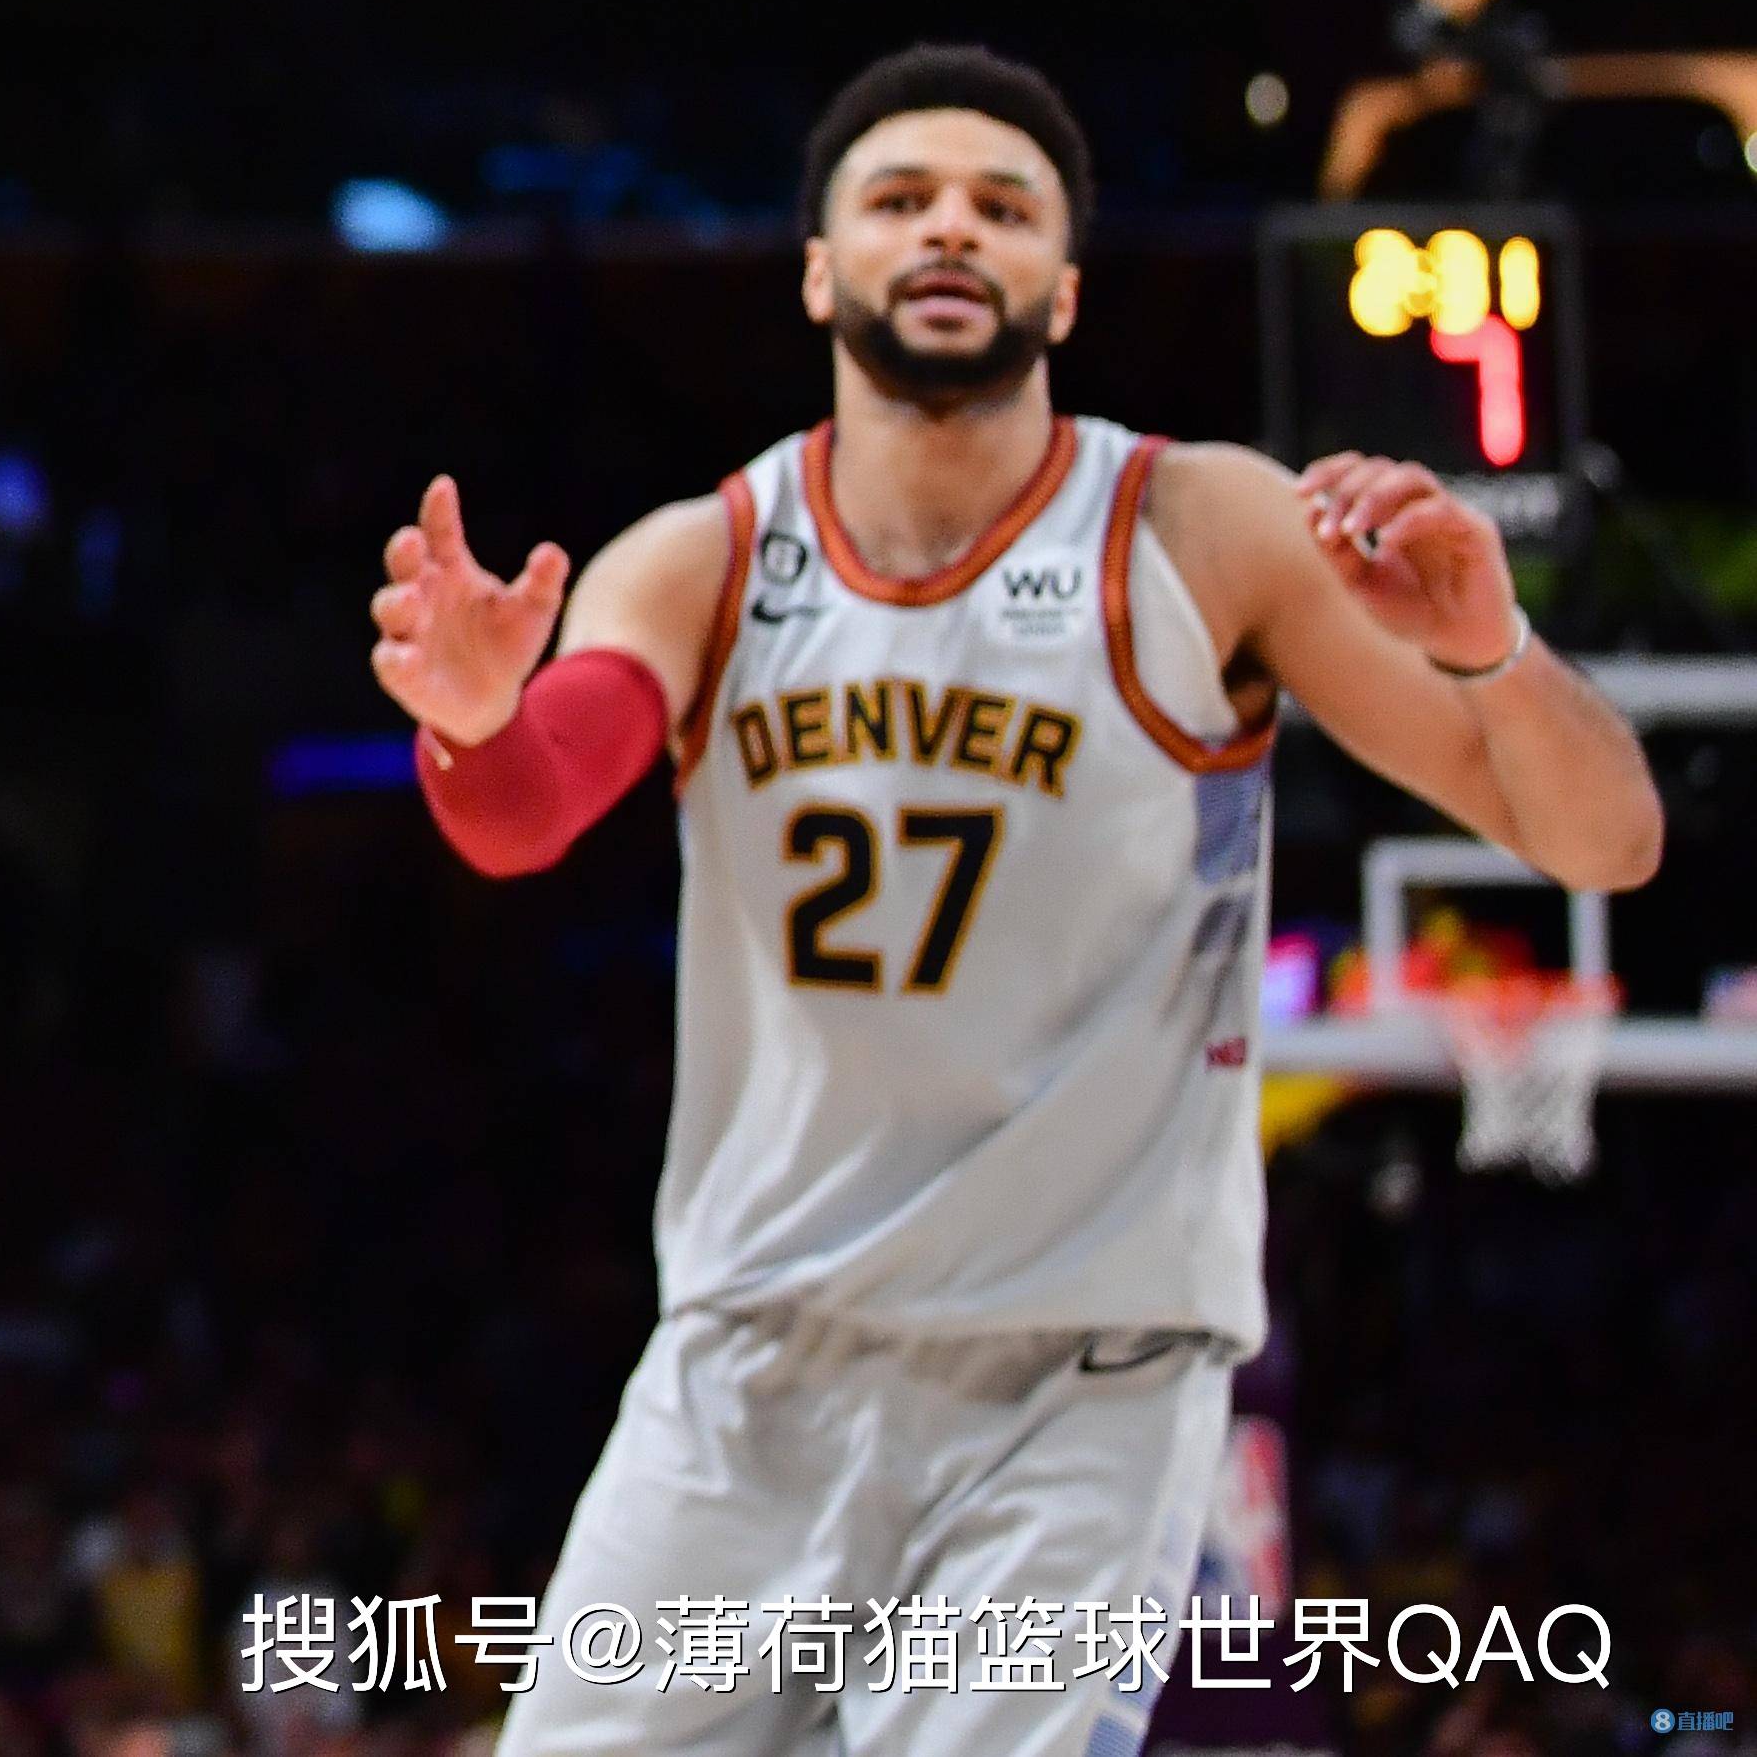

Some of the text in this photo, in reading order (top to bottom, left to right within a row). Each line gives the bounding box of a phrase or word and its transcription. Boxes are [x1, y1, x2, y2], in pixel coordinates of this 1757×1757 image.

[1002, 565, 1082, 600] WU
[730, 678, 1083, 797] DENVER
[783, 800, 1004, 995] 27
